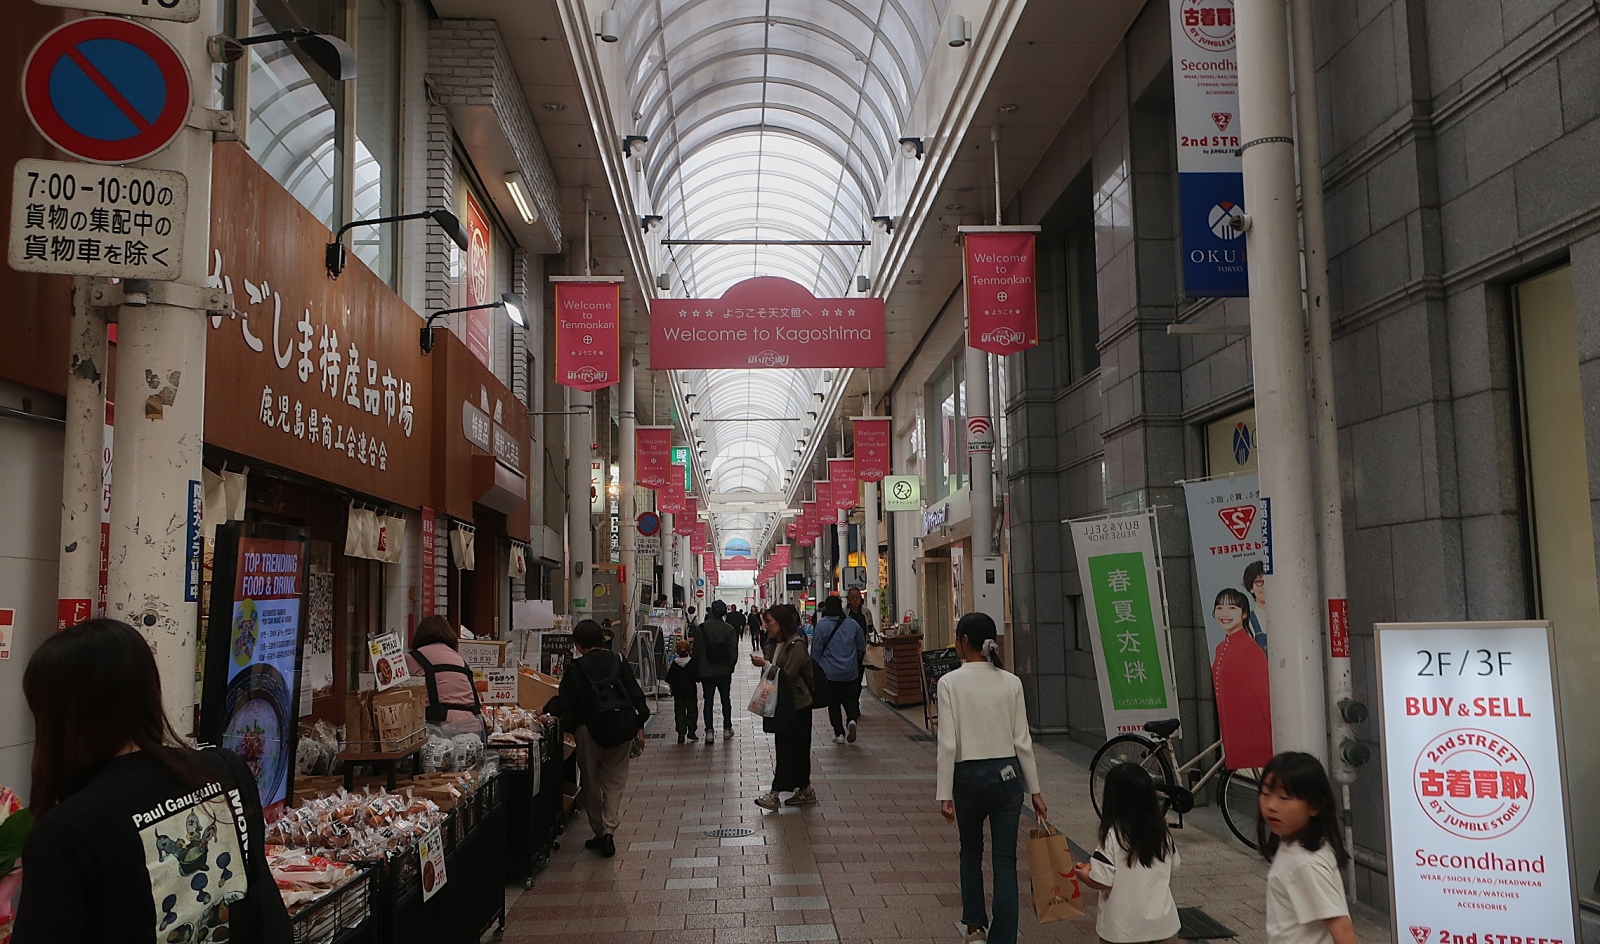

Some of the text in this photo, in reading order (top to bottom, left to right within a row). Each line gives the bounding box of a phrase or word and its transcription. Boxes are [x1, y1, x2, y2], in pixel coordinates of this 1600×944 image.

[1184, 7, 1235, 26] 古着買
[1190, 27, 1200, 37] BY
[1198, 37, 1226, 47] JUMBLE
[1181, 136, 1208, 147] 2nd
[25, 203, 172, 237] 貨物の集配中の
[23, 234, 169, 267] 貨物車を除く
[974, 253, 1027, 264] Welcome
[1190, 249, 1246, 263] OKU
[996, 265, 1007, 274] to
[971, 275, 1031, 285] Tenmonkan
[563, 300, 611, 310] Welcome
[722, 306, 813, 319] ようこそ天文館へ
[560, 320, 614, 329] Tenmonkan
[663, 326, 872, 344] Welcome to Kagoshima
[259, 385, 388, 471] 鹿児島県商工会連合会
[244, 552, 298, 573] TOP TRENDING
[242, 576, 296, 596] FOOD & DRINK
[479, 649, 498, 658] SOUP
[1416, 650, 1451, 676] 2F
[1476, 649, 1512, 676] 3F
[495, 691, 510, 700] 460
[1427, 733, 1518, 764] 2nd STREET
[1419, 768, 1529, 801] 古着買取
[132, 782, 222, 828] Paul Gauguin
[1429, 799, 1521, 832] BY JUMBLE STORE
[1415, 849, 1546, 874] Secondhand
[1457, 901, 1508, 911] ACCESSORIES
[1439, 929, 1477, 944] 2nd
